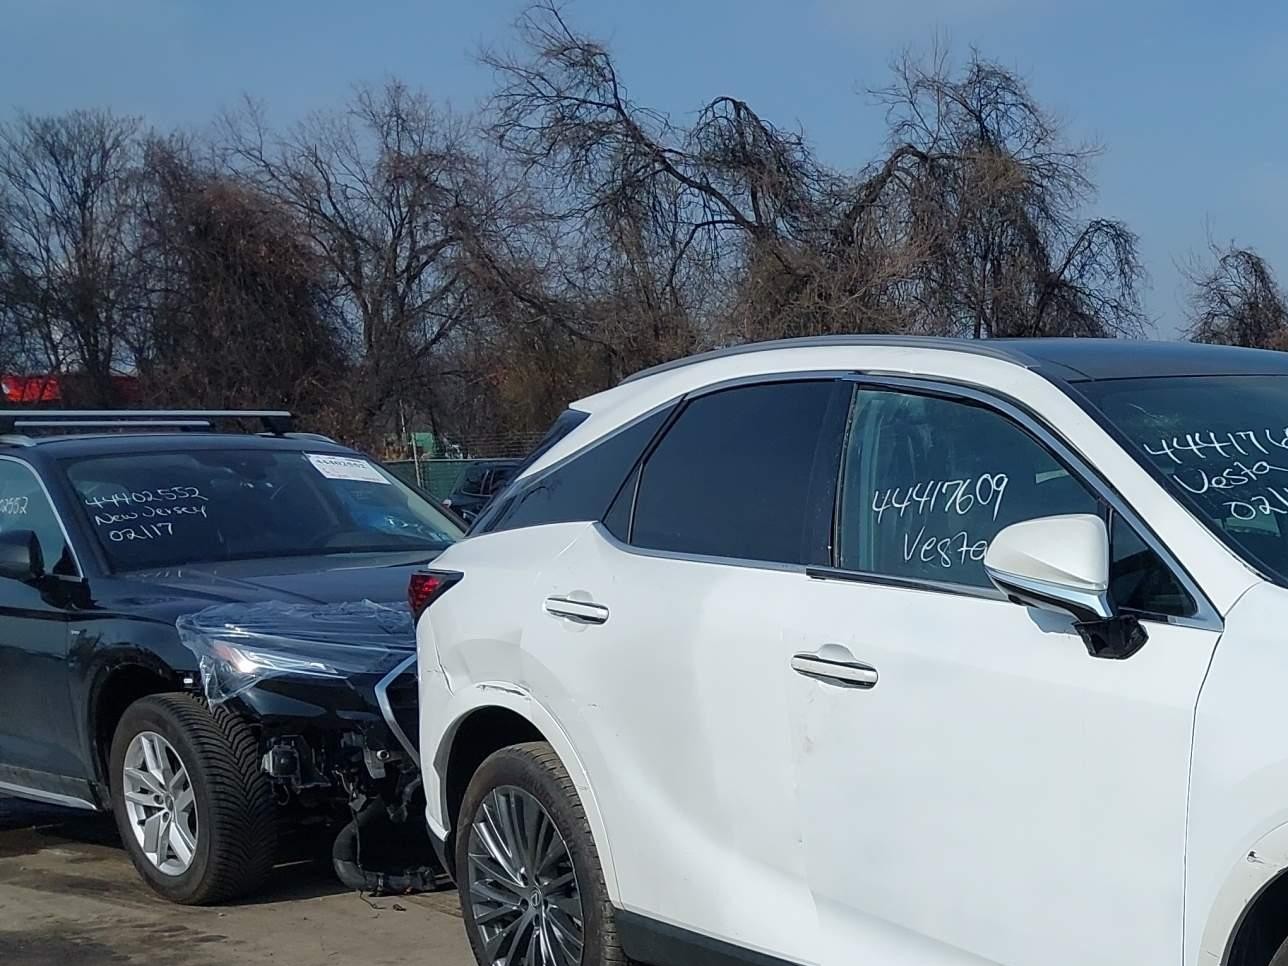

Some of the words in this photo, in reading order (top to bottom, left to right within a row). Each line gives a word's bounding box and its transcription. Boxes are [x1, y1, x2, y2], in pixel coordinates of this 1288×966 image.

[85, 487, 208, 508] 44402552
[872, 473, 1008, 524] 44417609
[95, 513, 138, 525] New
[142, 505, 206, 518] Jersey
[110, 522, 172, 541] 02/17
[904, 526, 987, 567] Vesta
